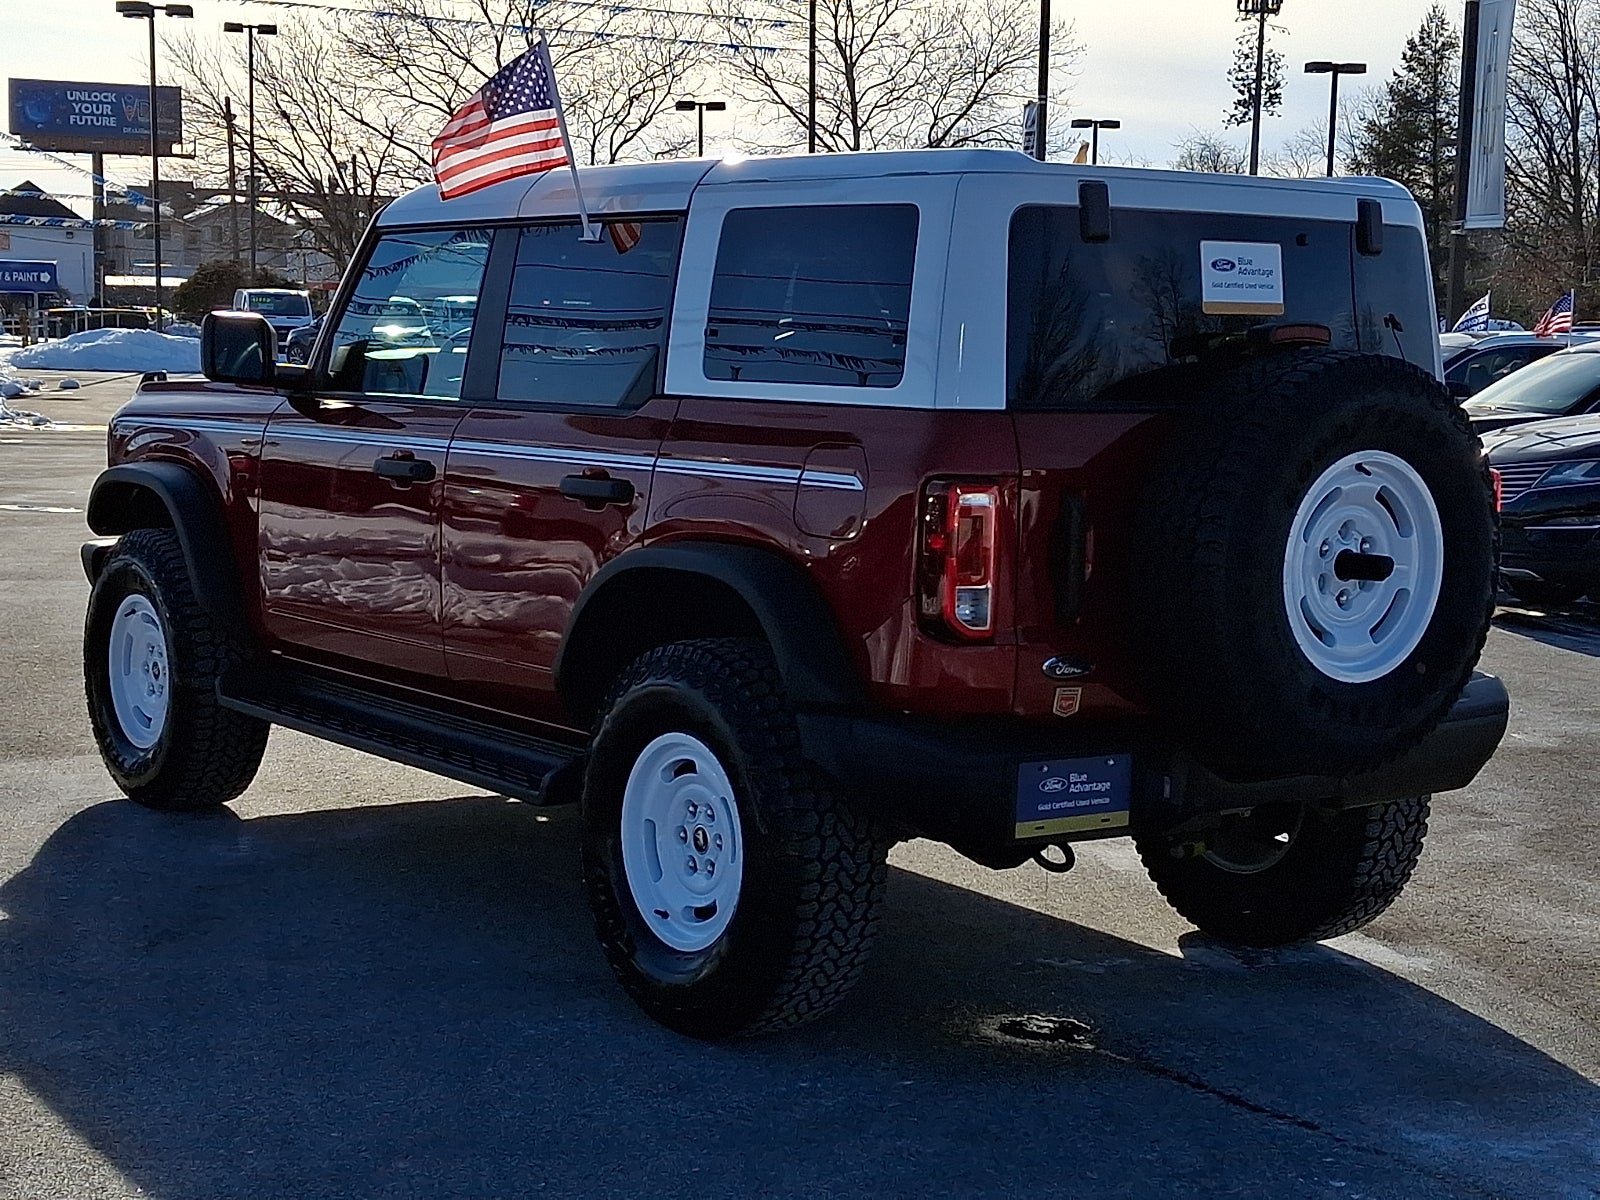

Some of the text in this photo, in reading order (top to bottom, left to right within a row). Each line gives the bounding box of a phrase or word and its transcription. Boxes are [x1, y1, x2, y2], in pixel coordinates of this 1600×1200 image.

[66, 90, 117, 103] UNLOCK
[72, 102, 112, 115] YOUR
[69, 115, 117, 127] FUTURE
[1237, 257, 1253, 266] Blue
[4, 271, 11, 281] &
[12, 271, 39, 282] PAINT
[1238, 266, 1274, 278] Advantage
[1069, 773, 1088, 783] Blue
[1068, 781, 1111, 793] Advantage
[1037, 797, 1110, 811] Gold Certified Used Vehicle
